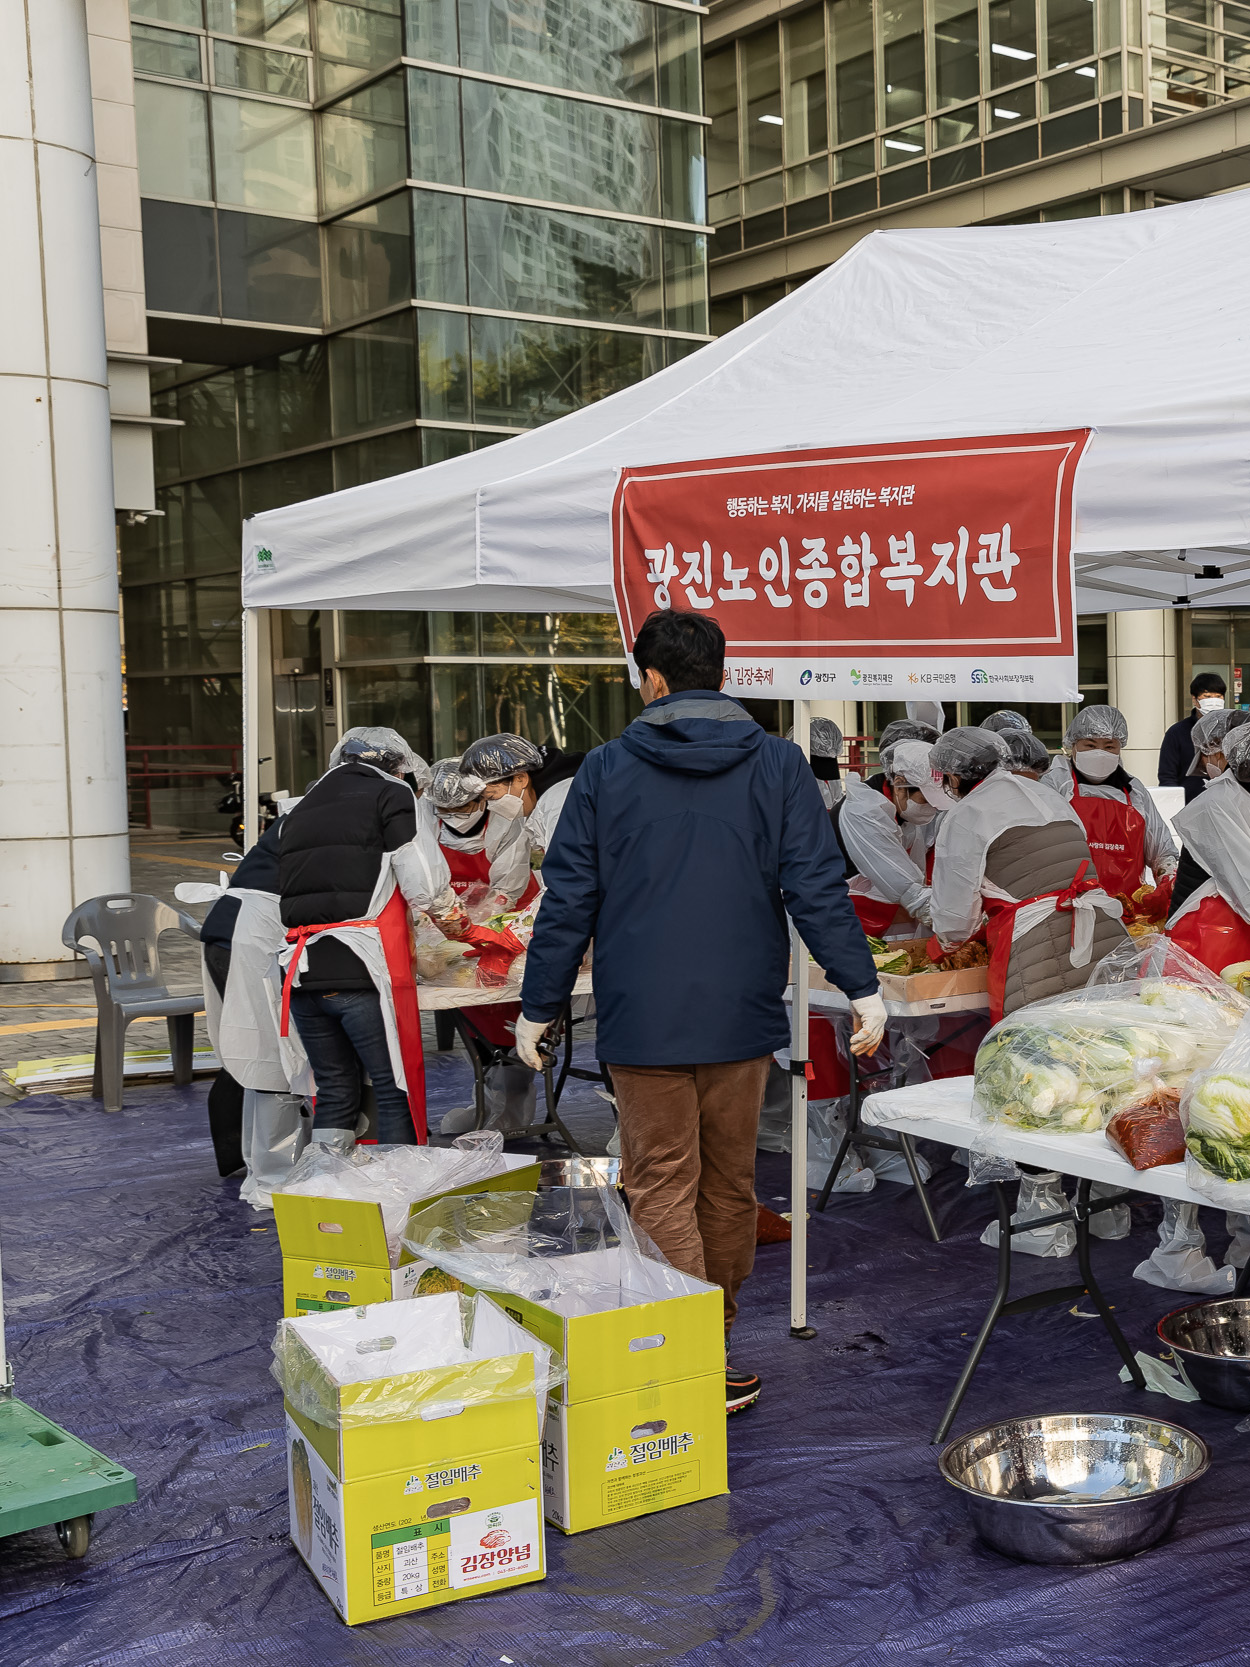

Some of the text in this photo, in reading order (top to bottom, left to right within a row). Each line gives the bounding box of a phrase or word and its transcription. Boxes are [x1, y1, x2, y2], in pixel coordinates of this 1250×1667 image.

[726, 484, 915, 517] 행동하는 복지, 가치를 실현하는 복지관
[644, 523, 1020, 609] 광진노인종합복지관
[734, 667, 774, 686] 김장축제
[815, 673, 836, 683] 광진구
[862, 673, 893, 683] 광진복지재단
[920, 673, 957, 684] KB국민은행
[324, 1266, 356, 1282] 절임배추
[629, 1432, 694, 1464] 절임배추
[425, 1464, 482, 1489] 절임배추
[413, 1522, 443, 1536] 표 시
[376, 1541, 424, 1560] 품명 절임배추
[431, 1552, 446, 1560] 주소
[460, 1543, 531, 1574] 김장양념
[376, 1557, 418, 1574] 산지 괴산
[432, 1565, 446, 1575] 성명
[377, 1572, 420, 1587] 중량 20kg
[432, 1578, 447, 1588] 전화
